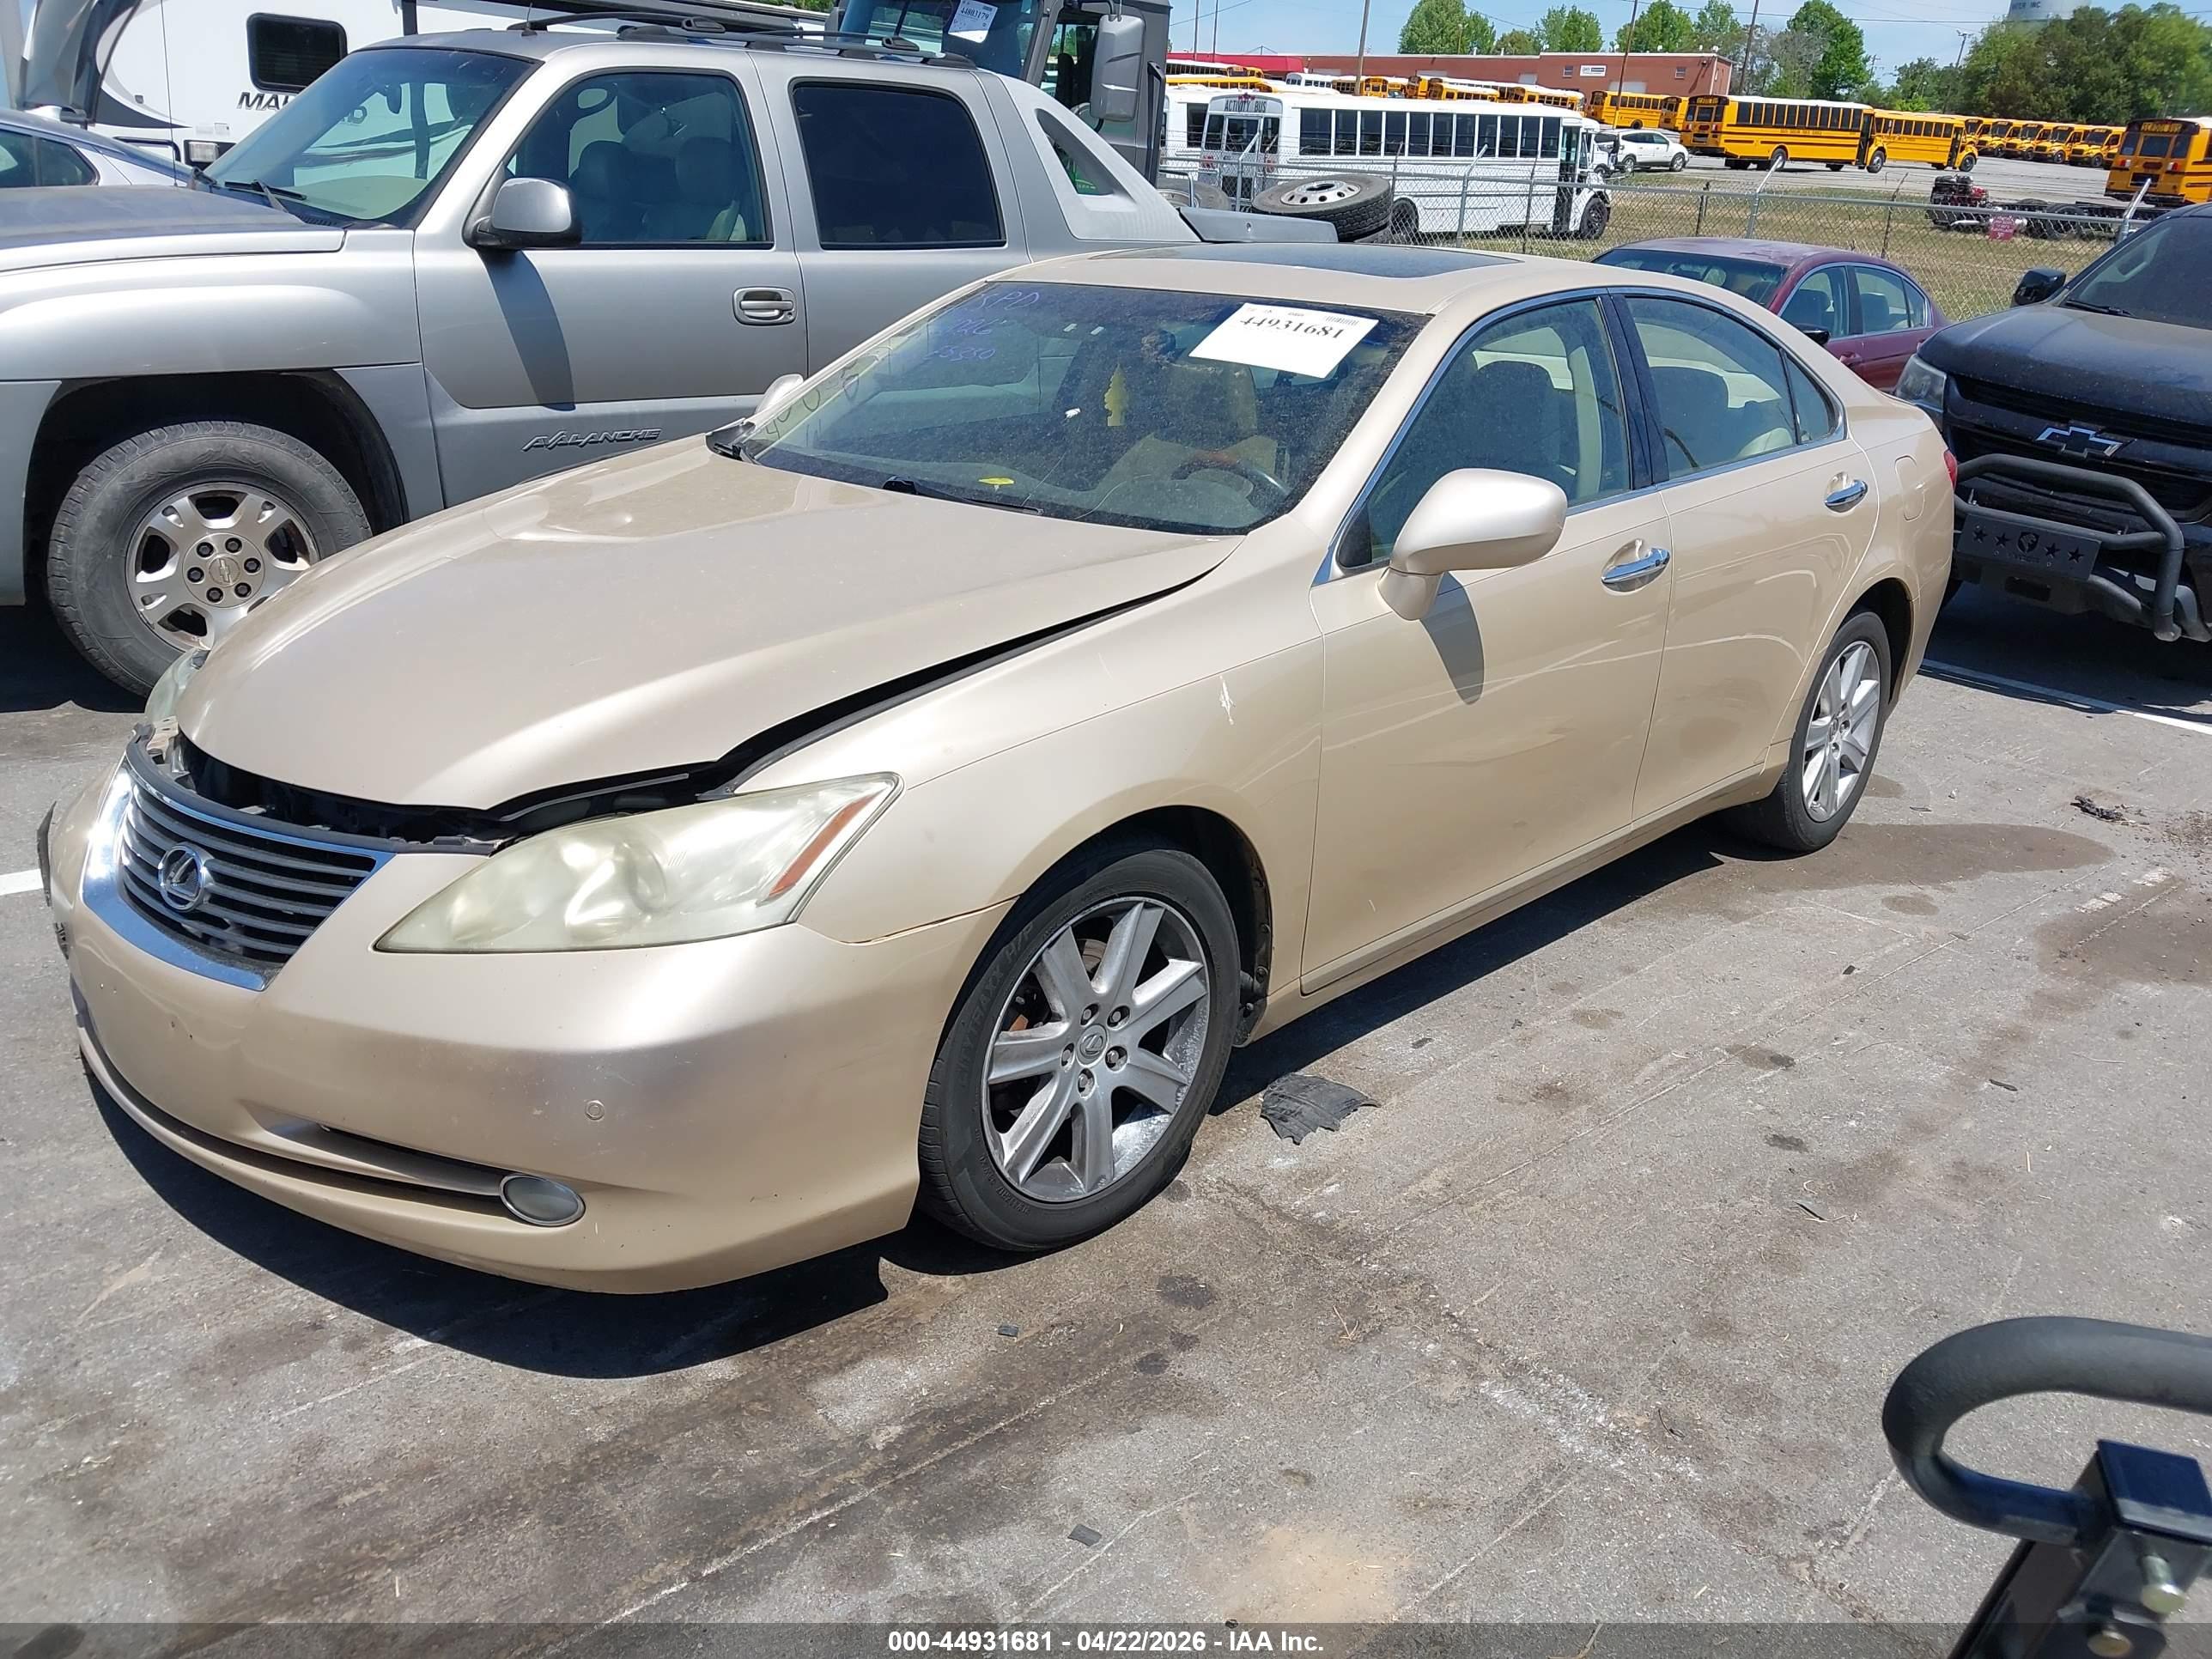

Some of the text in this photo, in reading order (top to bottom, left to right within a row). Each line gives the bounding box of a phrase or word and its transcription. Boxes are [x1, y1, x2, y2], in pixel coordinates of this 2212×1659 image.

[1224, 99, 1267, 113] ACTIVITY BUS
[1240, 315, 1345, 339] 44931681
[521, 428, 662, 452] AVALANCHE
